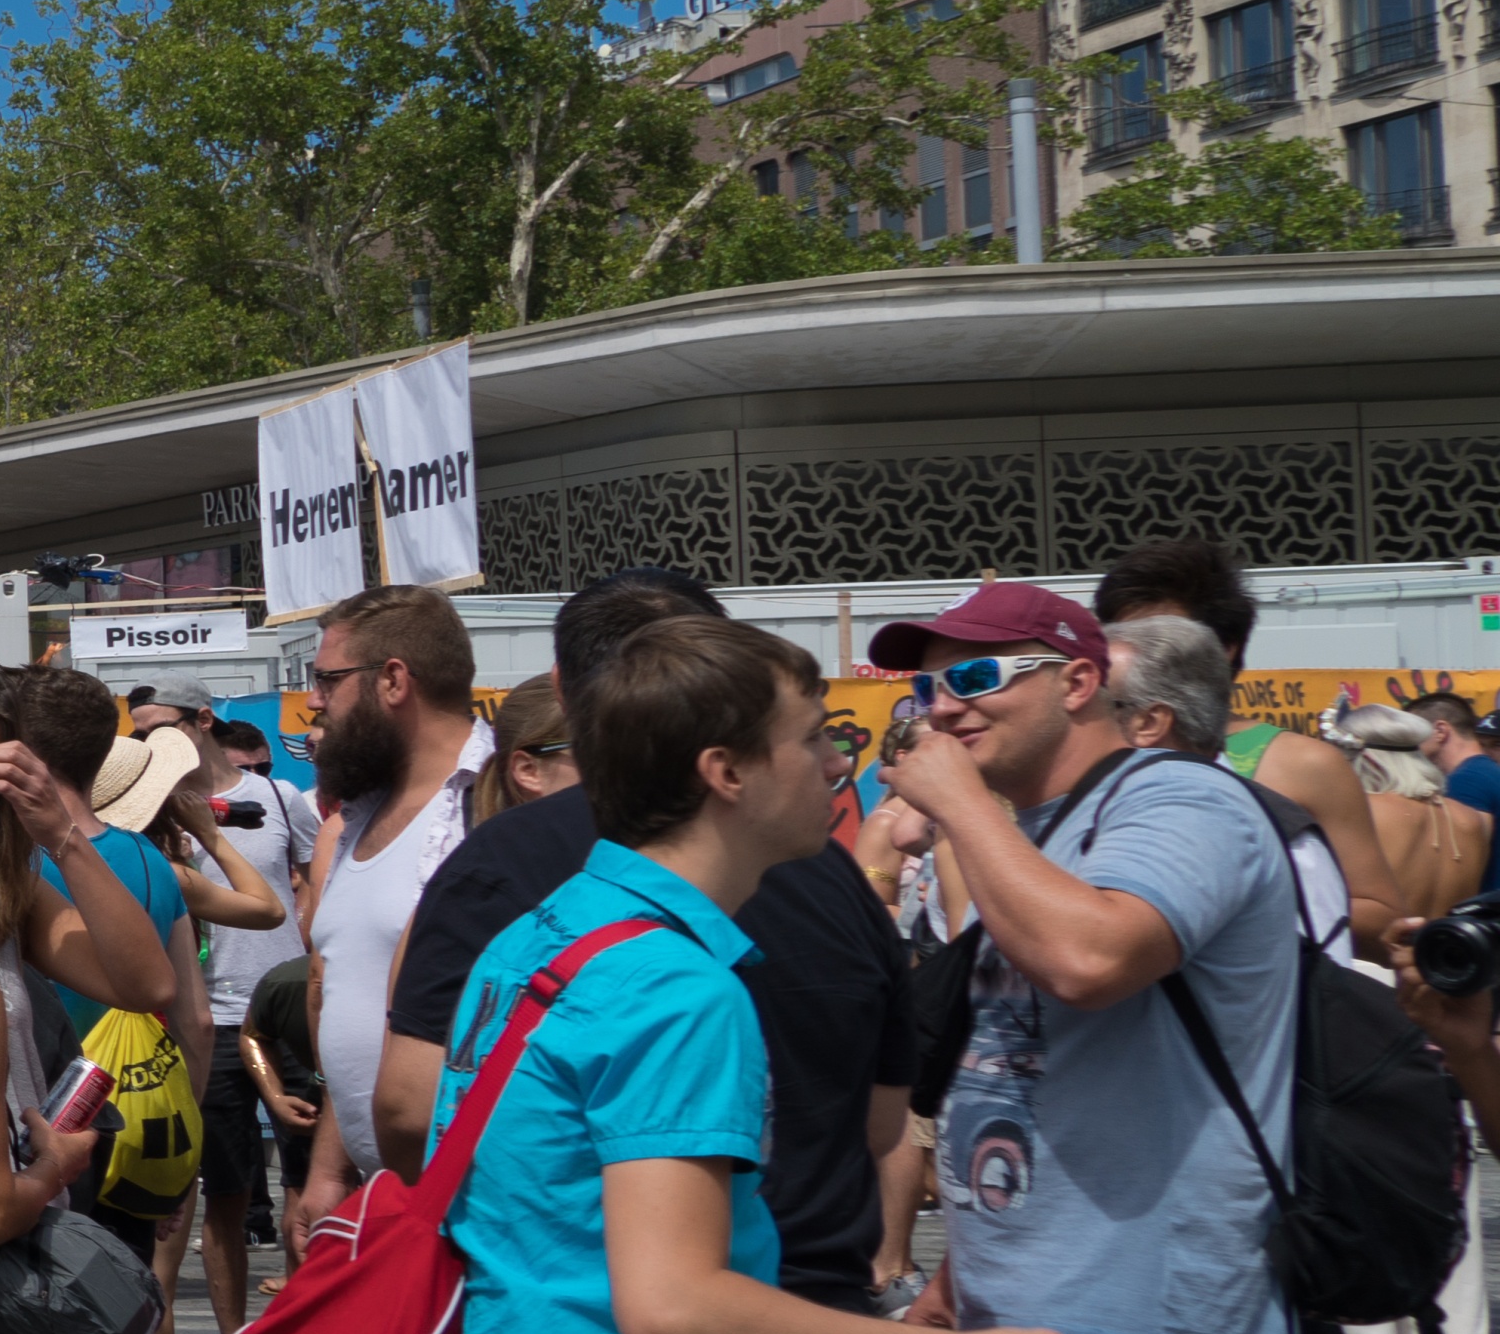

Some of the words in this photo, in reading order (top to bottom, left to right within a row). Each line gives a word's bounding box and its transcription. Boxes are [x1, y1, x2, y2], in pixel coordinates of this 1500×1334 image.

[269, 482, 358, 548] Herren
[106, 623, 212, 648] Pissoir
[1233, 678, 1282, 709] TURE
[1284, 680, 1305, 707] OF
